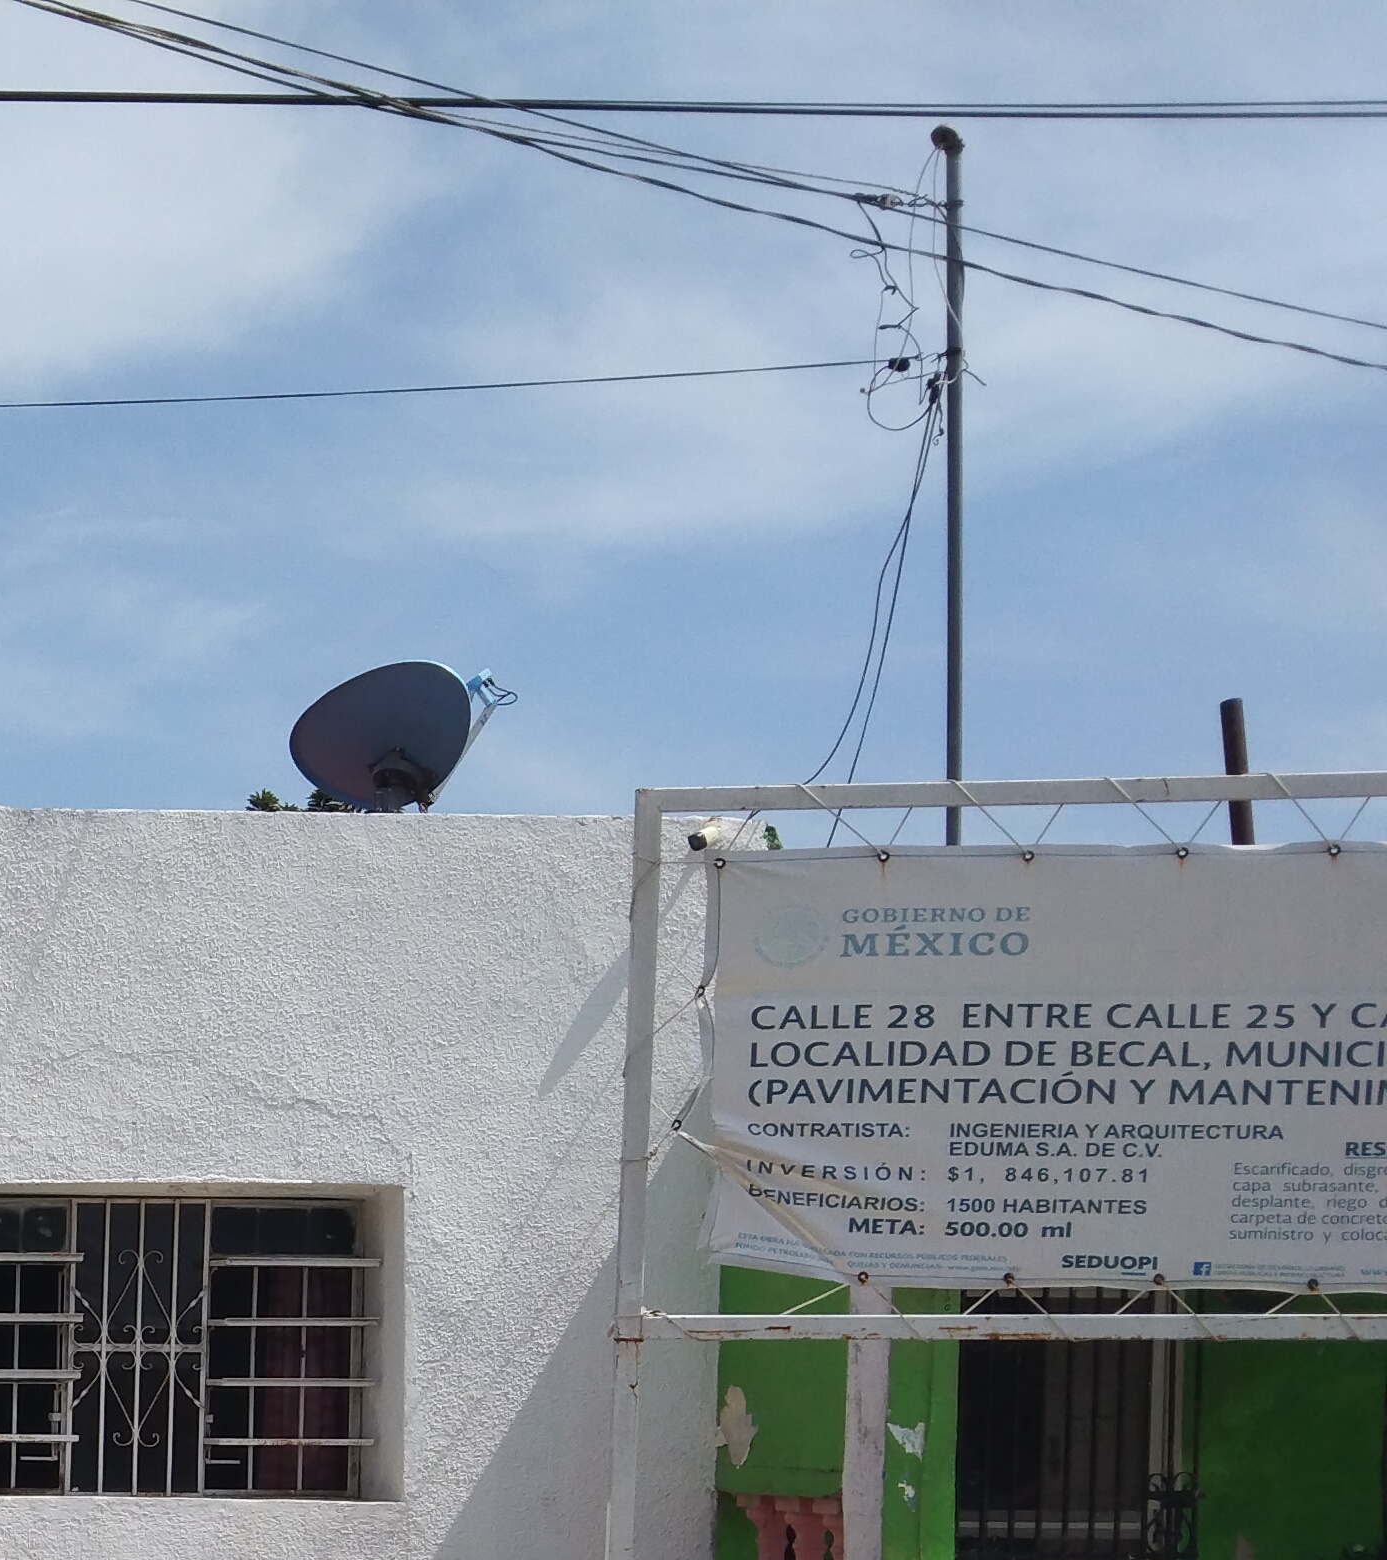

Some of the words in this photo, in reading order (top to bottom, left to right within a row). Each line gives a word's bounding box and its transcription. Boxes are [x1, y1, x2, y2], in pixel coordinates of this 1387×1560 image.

[841, 906, 986, 924] GOBIERNO
[995, 905, 1031, 923] DE
[839, 924, 1030, 957] MÉXICO
[750, 1004, 873, 1030] CALLE
[887, 1003, 935, 1029] 28
[962, 1003, 1092, 1029] ENTRE
[1106, 1003, 1231, 1029] CALLE
[1246, 1003, 1296, 1029] 25
[1311, 1003, 1337, 1029] Y
[1351, 1003, 1387, 1029] C
[749, 1040, 992, 1067] LOCALIDAD
[1004, 1040, 1057, 1067] DE
[1071, 1040, 1211, 1071] BECAL,
[748, 1071, 1116, 1107] (PAVIMENTACIÓN
[1130, 1079, 1156, 1105] Y
[747, 1122, 910, 1138] CONTRATISTA:
[949, 1123, 1079, 1139] INGENIERIA
[1085, 1124, 1099, 1139] Y
[1103, 1124, 1284, 1140] ARQUITECTURA
[949, 1141, 1029, 1157] EDUMA
[1035, 1142, 1077, 1158] S.A.
[1085, 1142, 1115, 1158] DE
[1122, 1143, 1163, 1158] C.V.
[746, 1158, 926, 1182] INVERSIÓN:
[1004, 1167, 1149, 1185] 846,107.81
[1233, 1162, 1334, 1177] Escarificado,
[1232, 1180, 1272, 1194] capa
[947, 1198, 995, 1214] 1500
[1003, 1198, 1147, 1215] HABITANTES
[848, 1217, 926, 1236] META:
[944, 1221, 1028, 1238] 500.00
[1041, 1221, 1072, 1238] ml
[1230, 1211, 1292, 1227] carpeta
[1297, 1211, 1317, 1225] de
[1229, 1227, 1314, 1241] suministro
[1322, 1230, 1332, 1244] y
[1061, 1255, 1158, 1271] SEDUOPI
